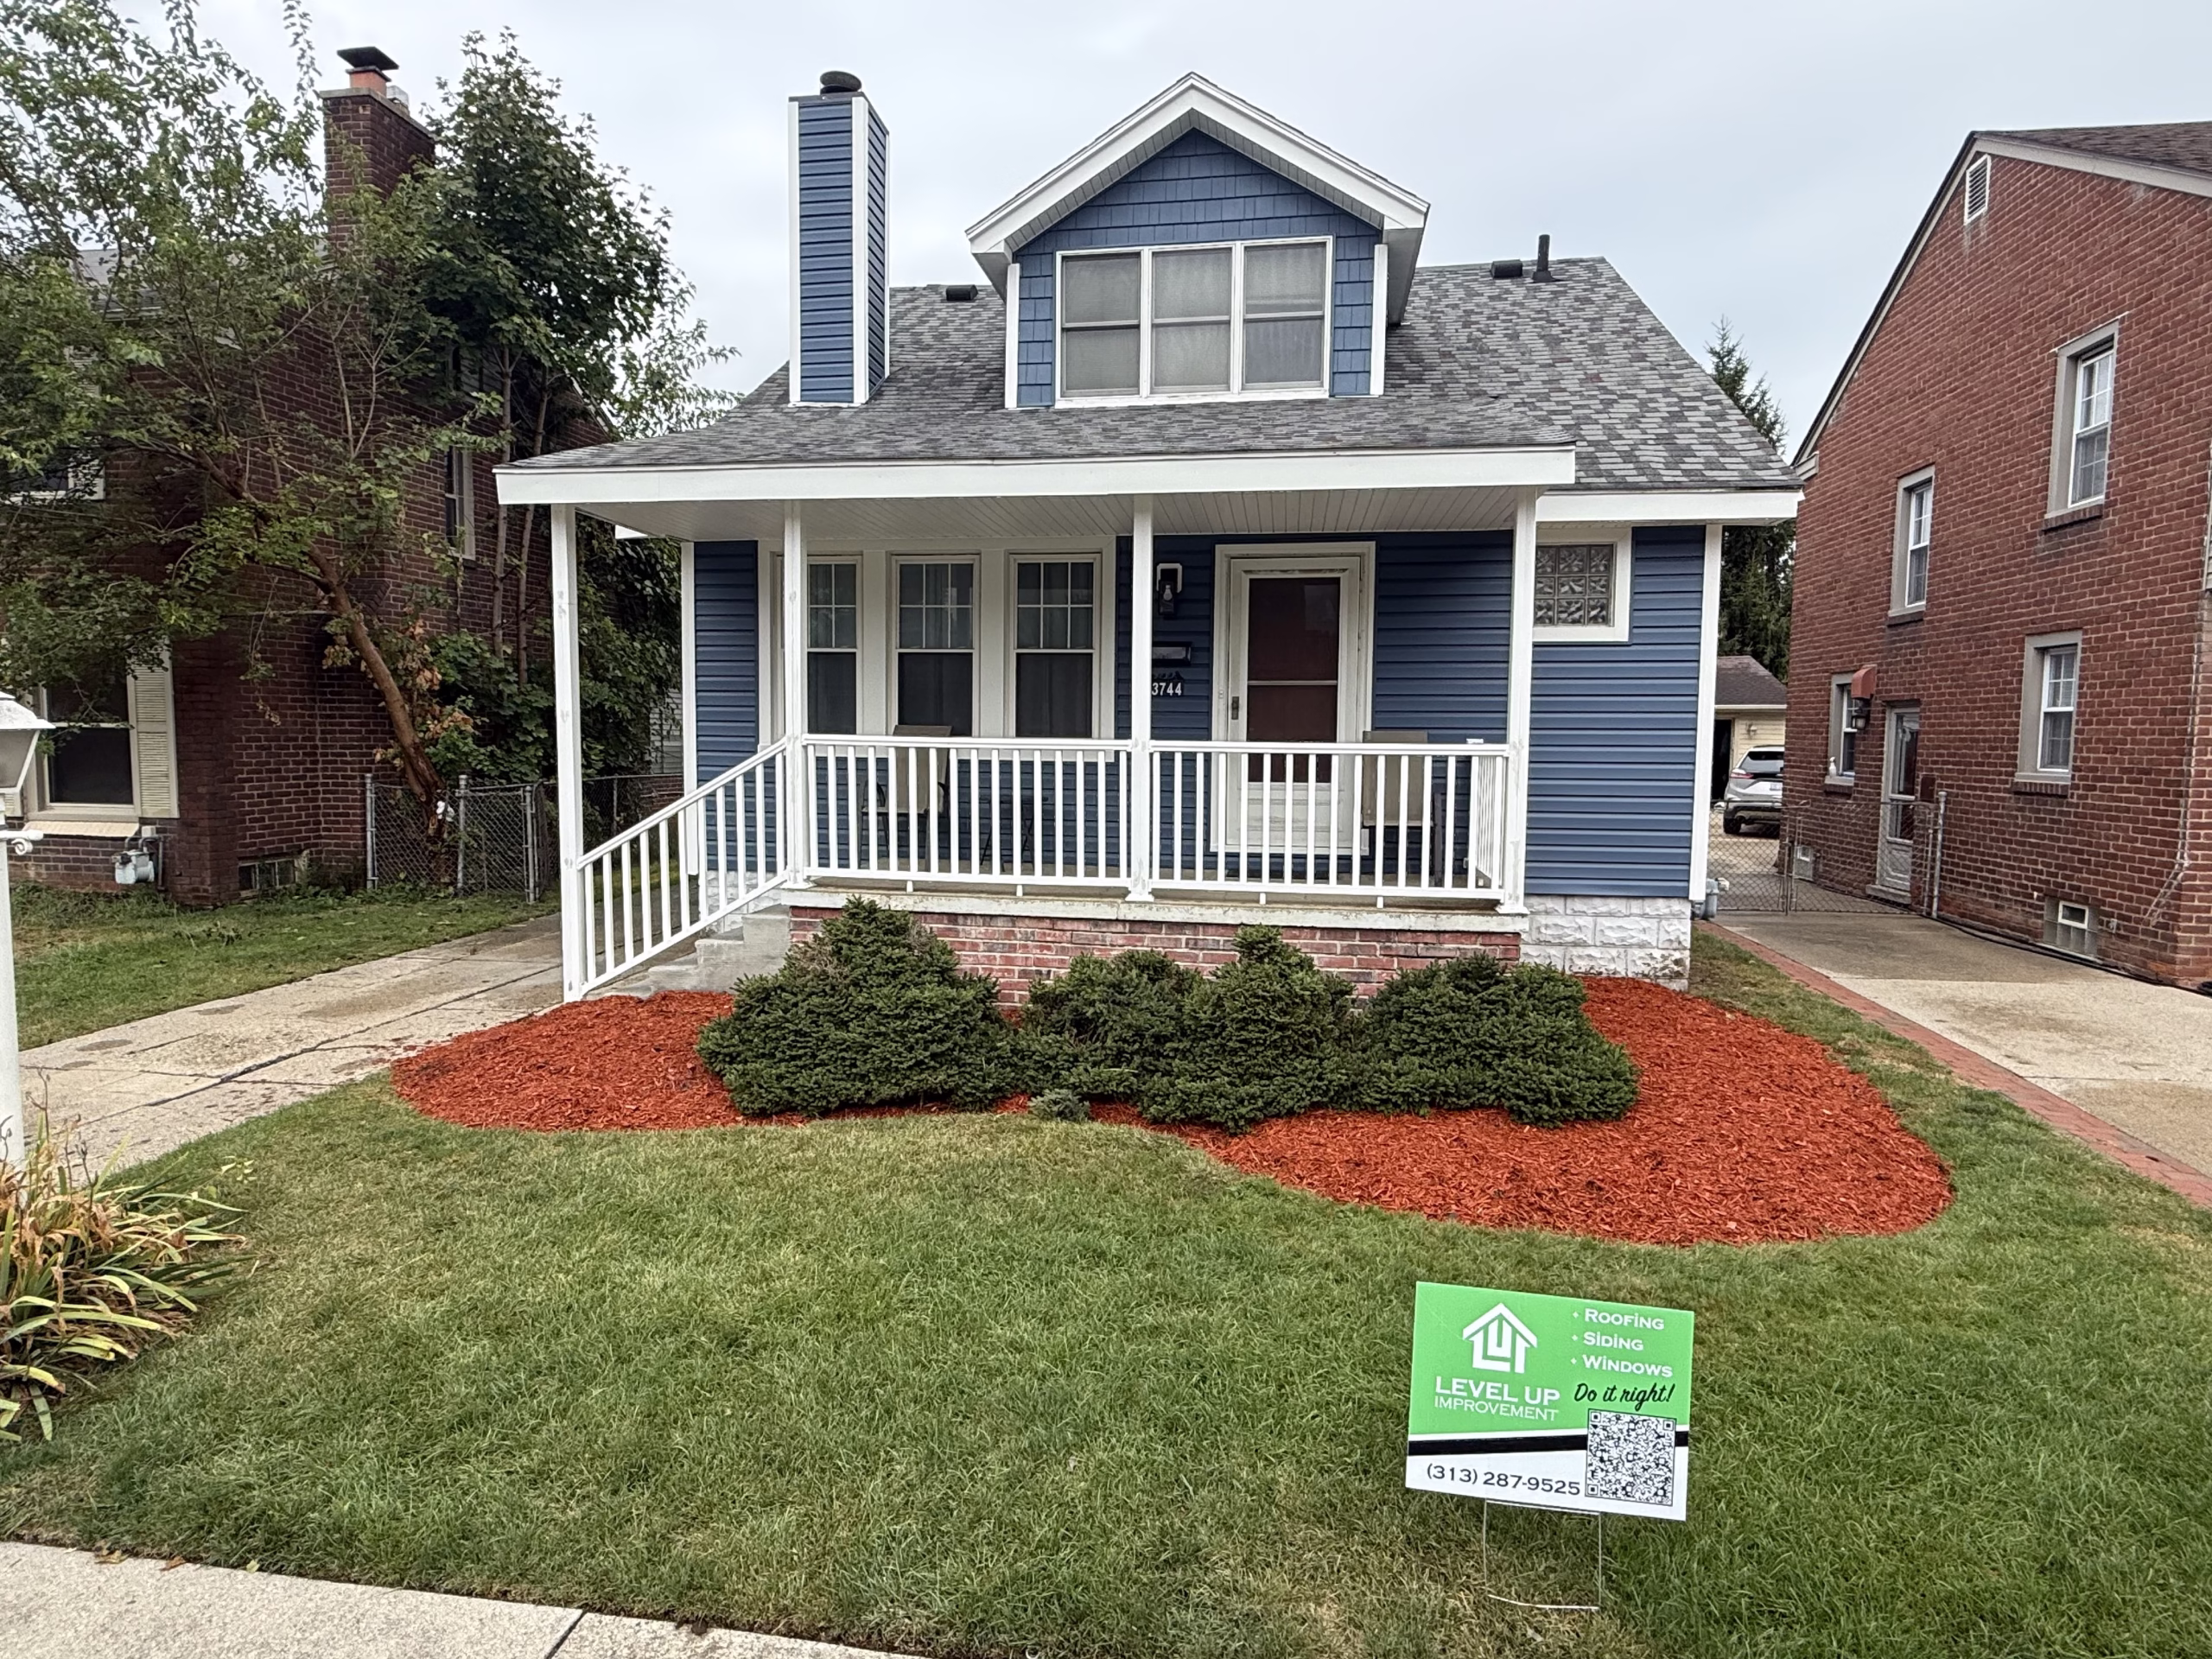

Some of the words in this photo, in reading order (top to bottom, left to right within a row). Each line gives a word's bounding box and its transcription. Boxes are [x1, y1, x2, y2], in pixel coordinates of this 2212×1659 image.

[1435, 1376, 1518, 1402] LEVEL
[1524, 1386, 1560, 1406] UP
[1573, 1382, 1598, 1402] Do
[1603, 1384, 1618, 1402] it
[1619, 1382, 1676, 1412] right!
[1434, 1395, 1560, 1421] IMPROVEMENT
[1427, 1463, 1478, 1484] (313)
[1483, 1471, 1580, 1497] 287-9525
